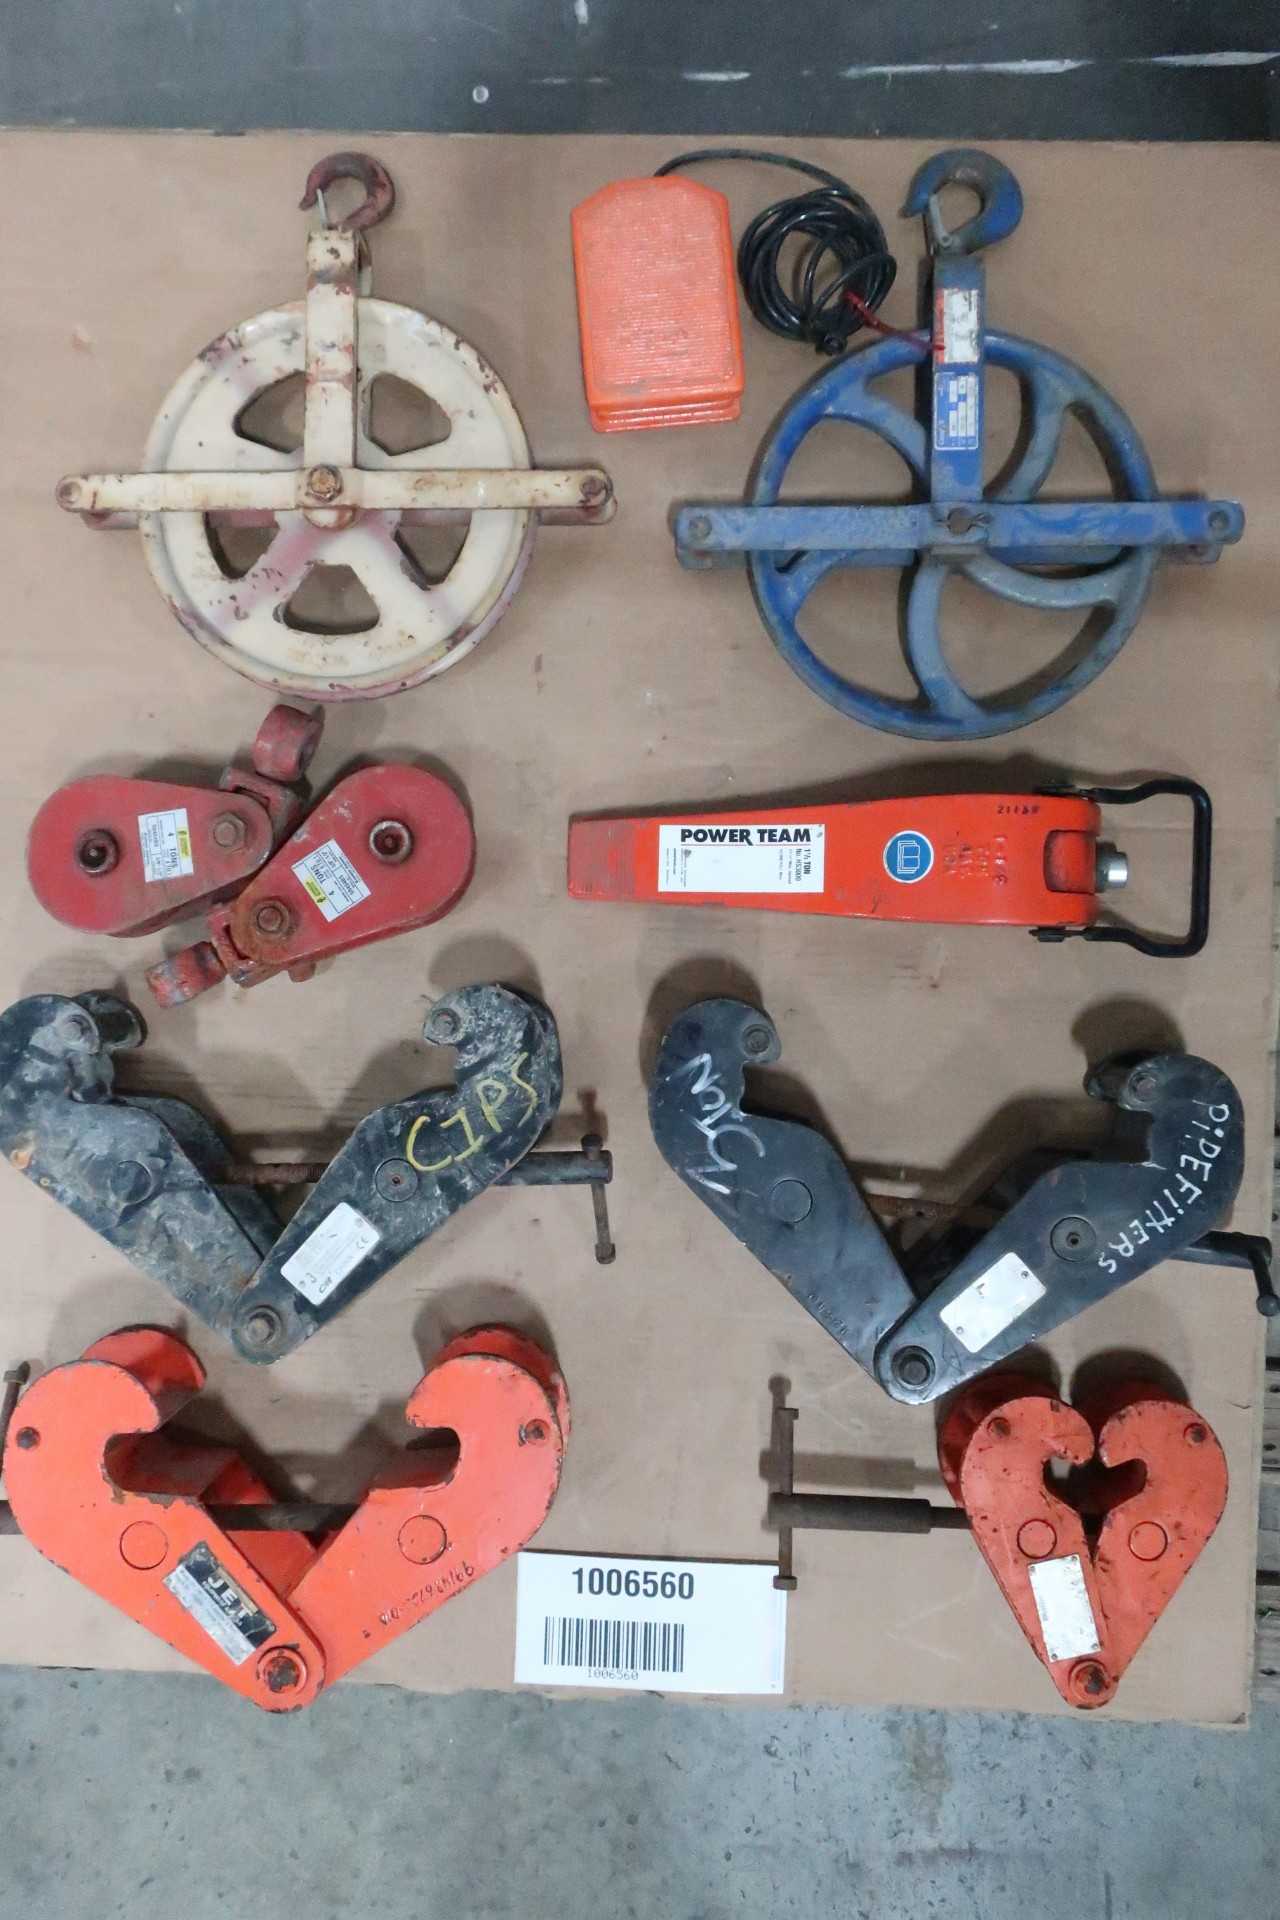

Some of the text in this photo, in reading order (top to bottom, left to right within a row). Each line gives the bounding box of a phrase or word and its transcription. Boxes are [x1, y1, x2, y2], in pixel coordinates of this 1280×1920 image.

[681, 828, 811, 846] POWER TEAM
[571, 1567, 695, 1600] 1006560
[207, 1575, 254, 1619] JET
[587, 1668, 640, 1681] 1006560
